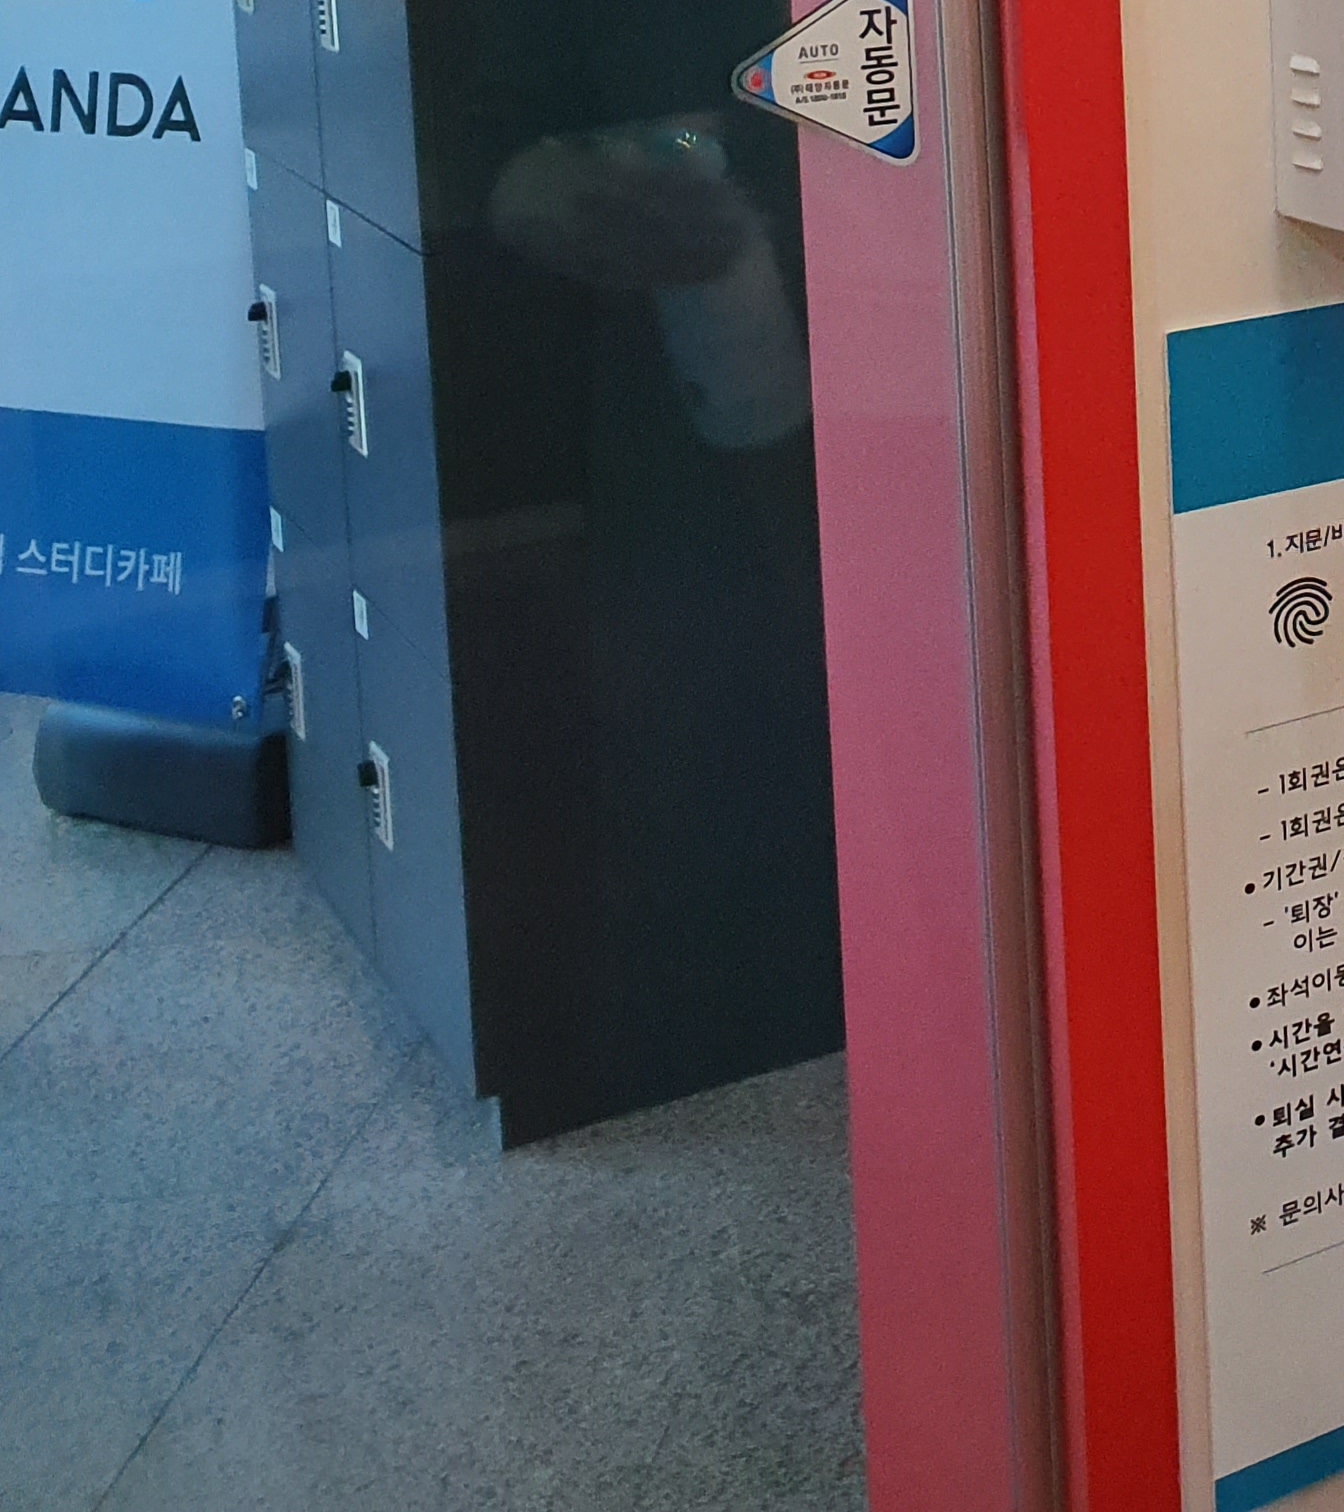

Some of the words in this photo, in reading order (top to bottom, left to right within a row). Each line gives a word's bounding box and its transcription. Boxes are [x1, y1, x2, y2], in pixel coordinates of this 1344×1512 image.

[798, 43, 840, 59] AUTO
[858, 6, 902, 127] 자동문
[16, 538, 183, 596] 스터디카페
[1293, 925, 1340, 953] 이는
[1269, 1011, 1335, 1050] 시간을
[1327, 1083, 1344, 1108] 시
[1273, 1125, 1317, 1158] 추가
